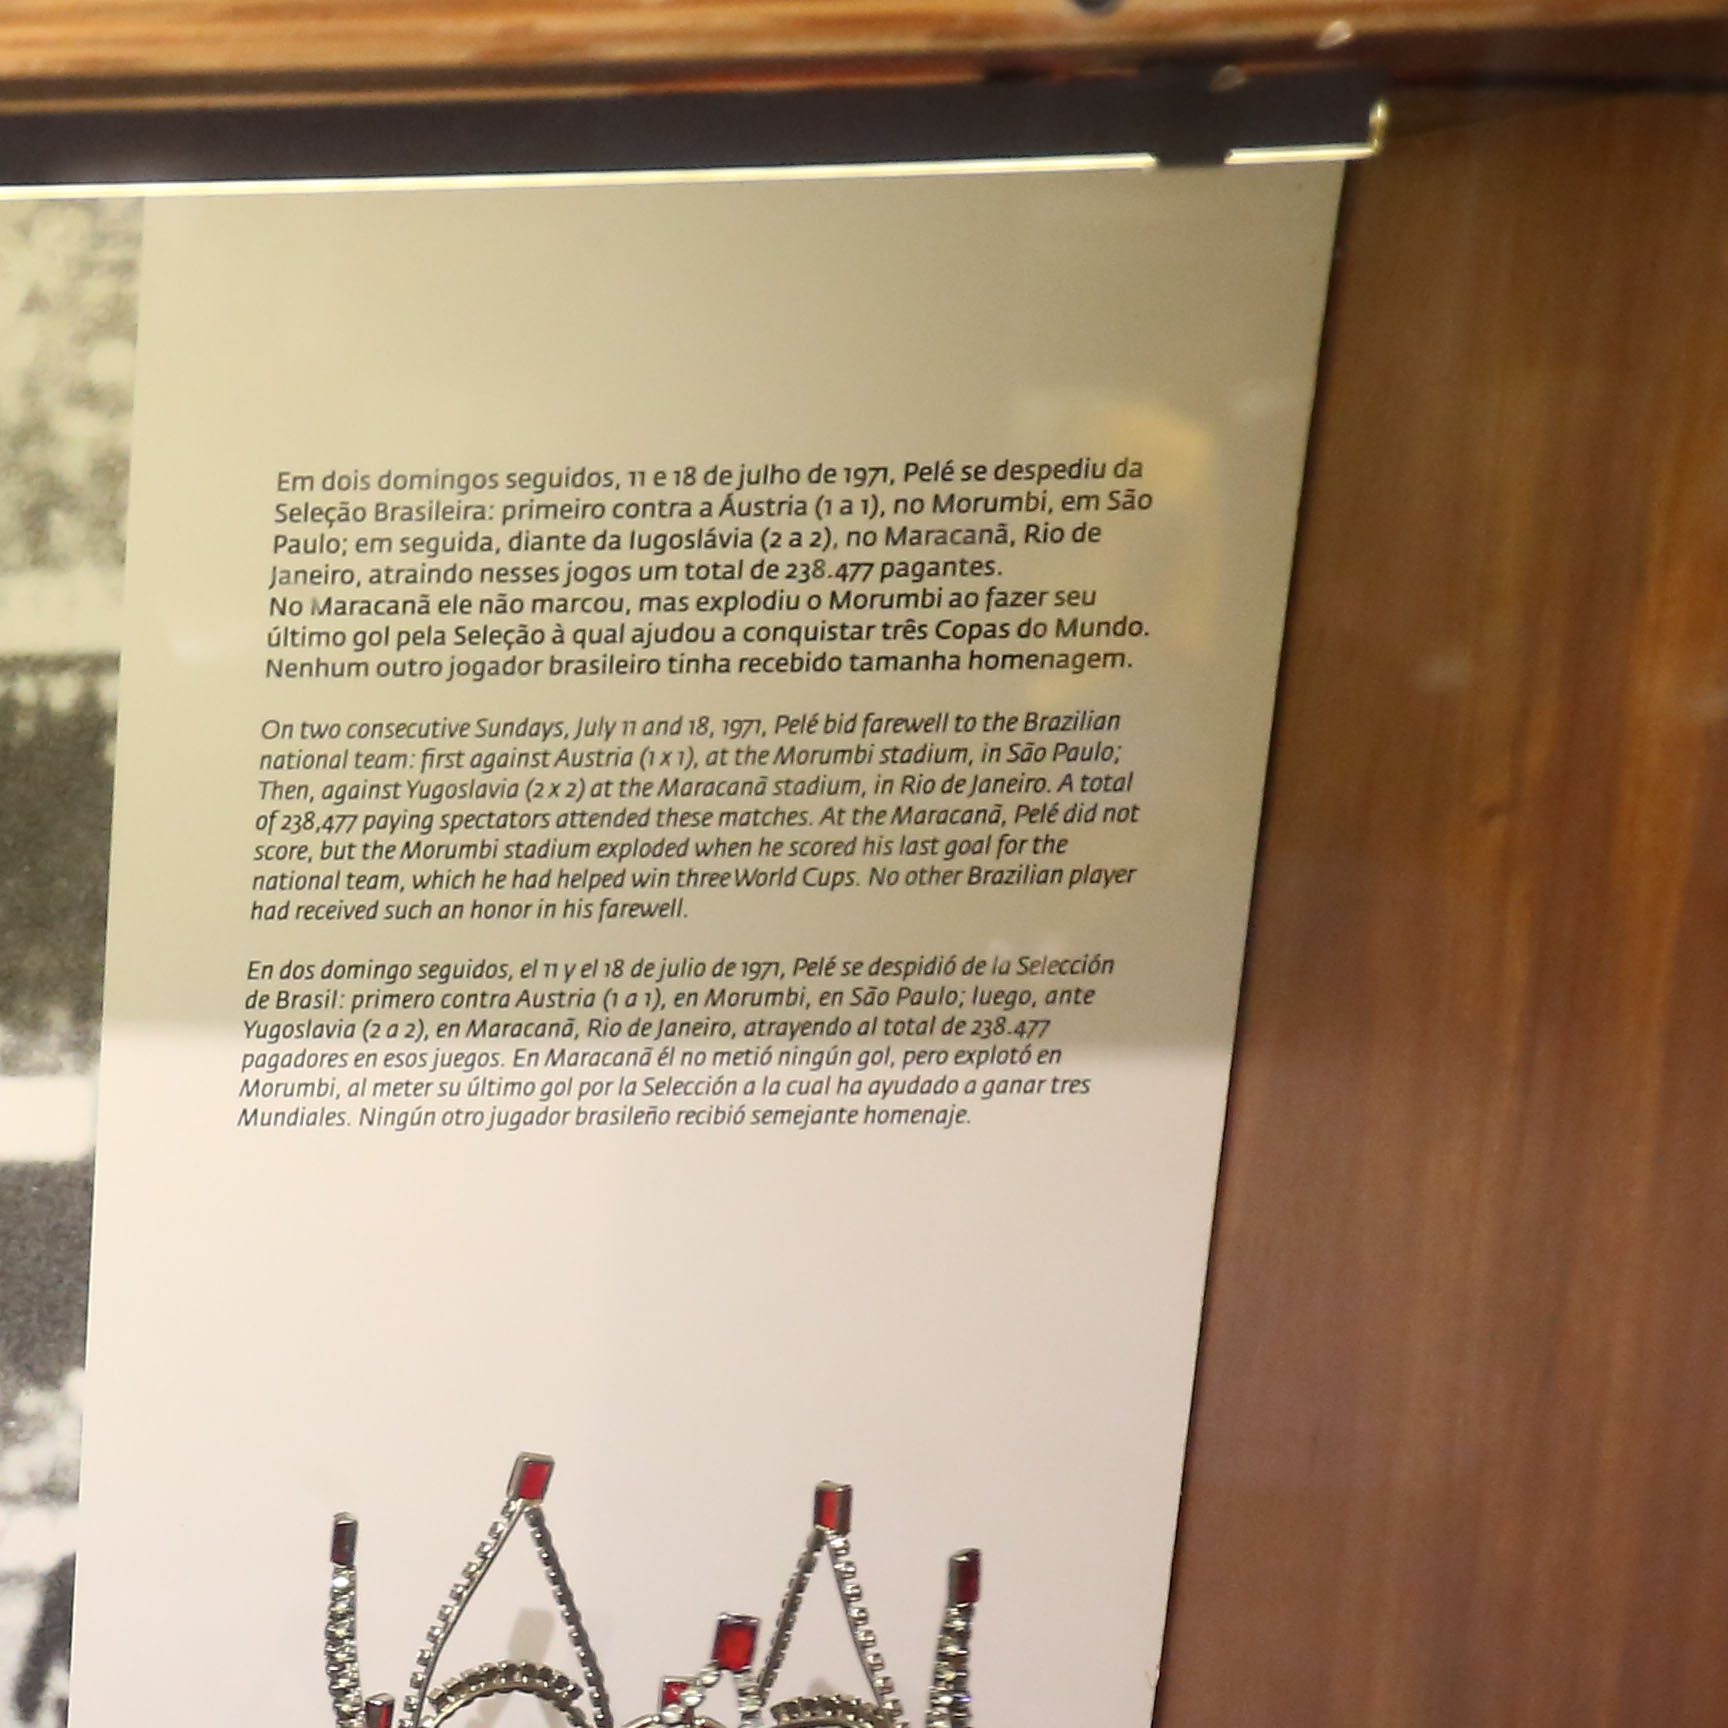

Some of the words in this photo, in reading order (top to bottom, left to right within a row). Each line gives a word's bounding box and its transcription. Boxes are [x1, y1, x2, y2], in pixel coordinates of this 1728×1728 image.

[276, 470, 315, 493] Em
[320, 468, 371, 492] dois
[376, 467, 500, 495] domingos
[504, 465, 621, 494] seguidos,
[626, 469, 647, 488] 11
[651, 469, 668, 488] e
[671, 464, 697, 487] 18
[702, 463, 733, 486] de
[734, 462, 801, 491] julho
[806, 461, 838, 485] de
[842, 465, 896, 488] 1971,
[902, 458, 955, 483] Pelé
[959, 463, 988, 482] se
[992, 456, 1107, 486] despediu
[1112, 456, 1144, 479] da
[266, 562, 361, 591] Janeiro,
[367, 561, 473, 585] atraindo
[479, 565, 560, 584] nesses
[561, 559, 632, 588] jogos
[637, 564, 678, 582] um
[684, 558, 744, 581] total
[749, 557, 780, 580] de
[783, 557, 875, 584] 238.477
[878, 557, 1003, 584] pagantes.
[264, 655, 369, 679] Nenhum
[375, 657, 443, 678] outro
[444, 654, 545, 682] jogador
[548, 652, 661, 676] brasileiro
[667, 651, 731, 675] tinha
[737, 650, 843, 674] recebido
[848, 649, 961, 673] tamanha
[967, 648, 1133, 675] homenagem.
[254, 808, 281, 836] of
[279, 809, 359, 835] 238,477
[361, 808, 435, 835] paying
[438, 810, 552, 835] spectators
[554, 806, 652, 829] attended
[655, 805, 714, 828] these
[717, 805, 813, 827] matches.
[817, 805, 847, 827] At
[850, 804, 888, 826] the
[889, 802, 1007, 828] Maracanã,
[1013, 801, 1060, 824] Pelé
[1062, 801, 1098, 824] did
[1101, 802, 1141, 824] not
[249, 899, 291, 921] had
[294, 898, 380, 921] received
[382, 898, 433, 921] such
[436, 903, 465, 920] an
[469, 898, 534, 920] honor
[536, 897, 557, 919] in
[561, 896, 594, 919] his
[597, 895, 689, 924] farewell.
[236, 1105, 351, 1127] Mundiales.
[358, 1104, 436, 1132] Ningún
[440, 1107, 485, 1127] otro
[484, 1104, 572, 1132] jugador
[574, 1104, 671, 1126] brasileño
[675, 1103, 746, 1126] recibió
[749, 1103, 859, 1130] semejante
[862, 1102, 971, 1130] homenaje.
